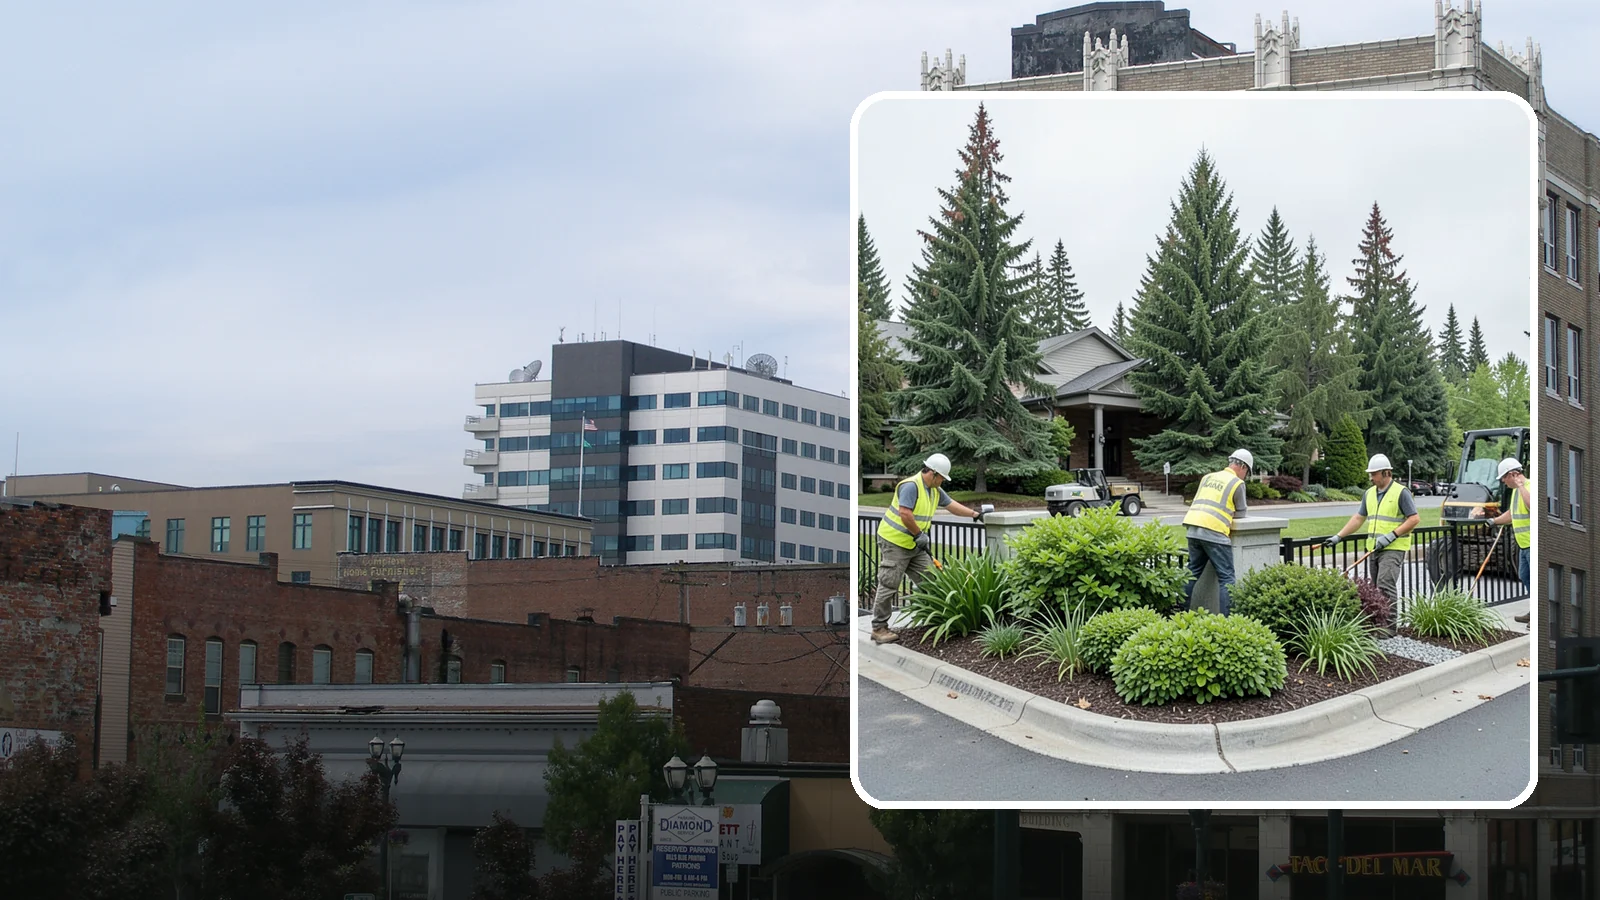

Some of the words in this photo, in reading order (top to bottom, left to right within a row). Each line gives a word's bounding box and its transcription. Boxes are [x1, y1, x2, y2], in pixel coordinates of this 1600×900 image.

[370, 566, 427, 576] Furnishers
[660, 818, 713, 833] DIAMOND
[1022, 815, 1069, 827] BUILDING
[617, 825, 625, 852] PAY
[628, 825, 636, 852] PAY
[721, 851, 739, 862] Soup
[671, 862, 701, 870] PATRONS
[1289, 855, 1330, 874] TAC
[1345, 856, 1385, 875] DEL
[1392, 857, 1442, 877] MAR
[616, 856, 625, 893] HERE
[627, 856, 636, 893] HERE
[660, 889, 682, 897] PUBLIC
[683, 889, 710, 898] PARKING
